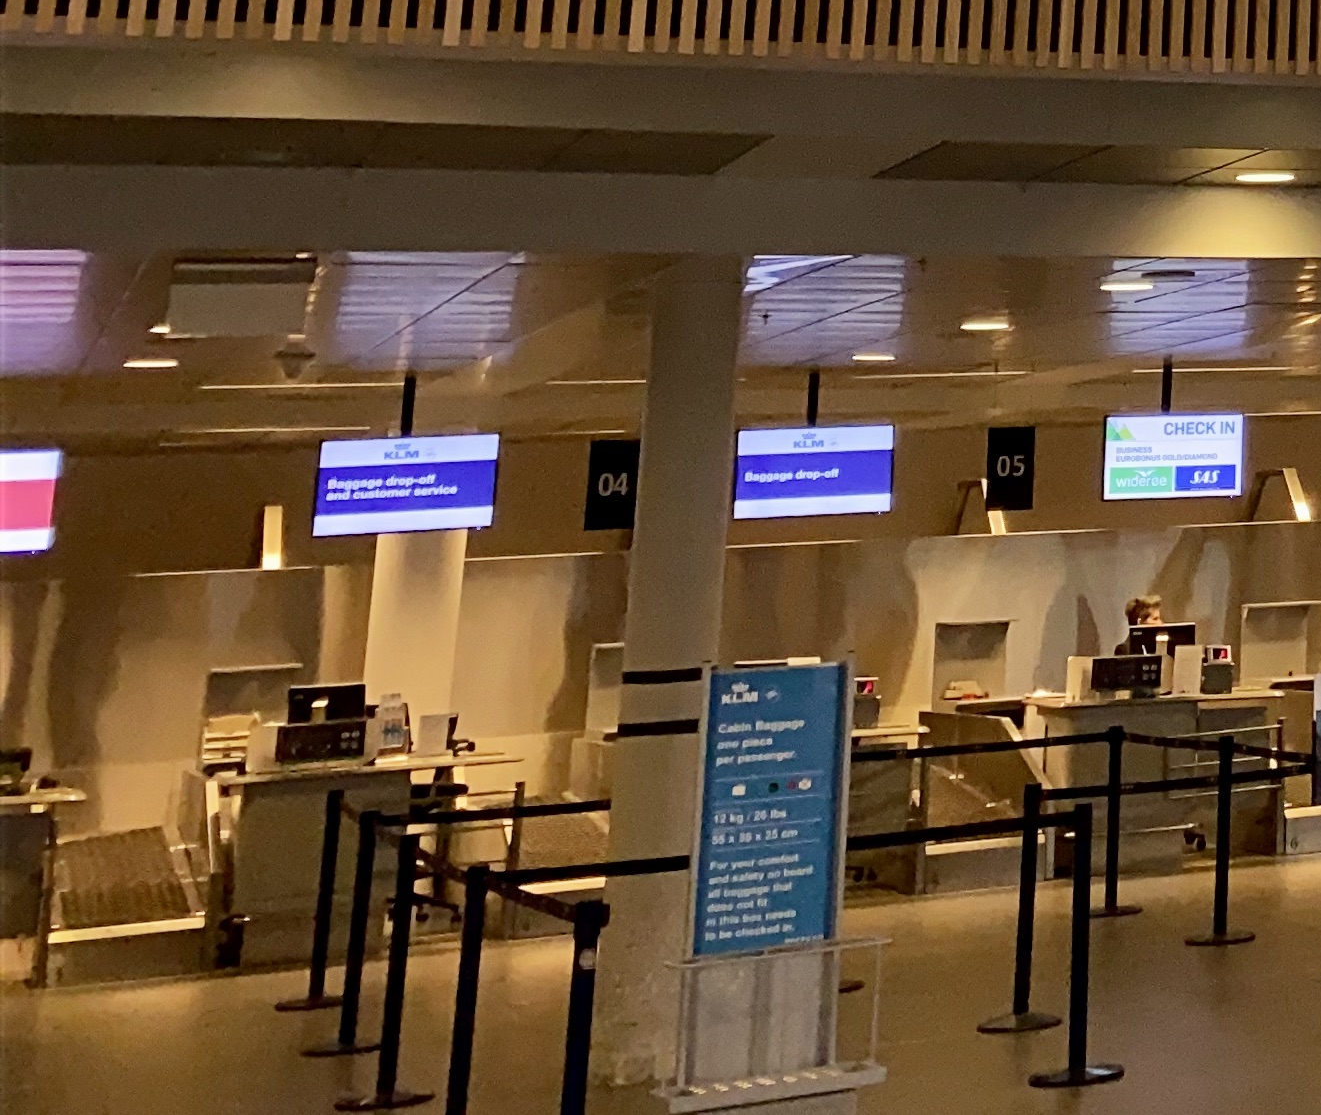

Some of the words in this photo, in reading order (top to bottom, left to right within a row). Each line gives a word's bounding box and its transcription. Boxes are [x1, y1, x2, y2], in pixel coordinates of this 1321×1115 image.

[1164, 422, 1215, 436] CHECK
[1220, 421, 1235, 434] IN
[793, 439, 825, 450] KLM
[384, 450, 419, 460] KLM
[996, 456, 1025, 477] 05
[327, 479, 383, 491] Baggage
[386, 474, 437, 487] drop-off
[744, 469, 794, 484] Baggage
[1190, 470, 1221, 484] SAS
[598, 473, 628, 497] 04
[326, 491, 349, 501] and
[353, 487, 411, 500] customer
[414, 485, 458, 496] service
[722, 691, 758, 704] KLM
